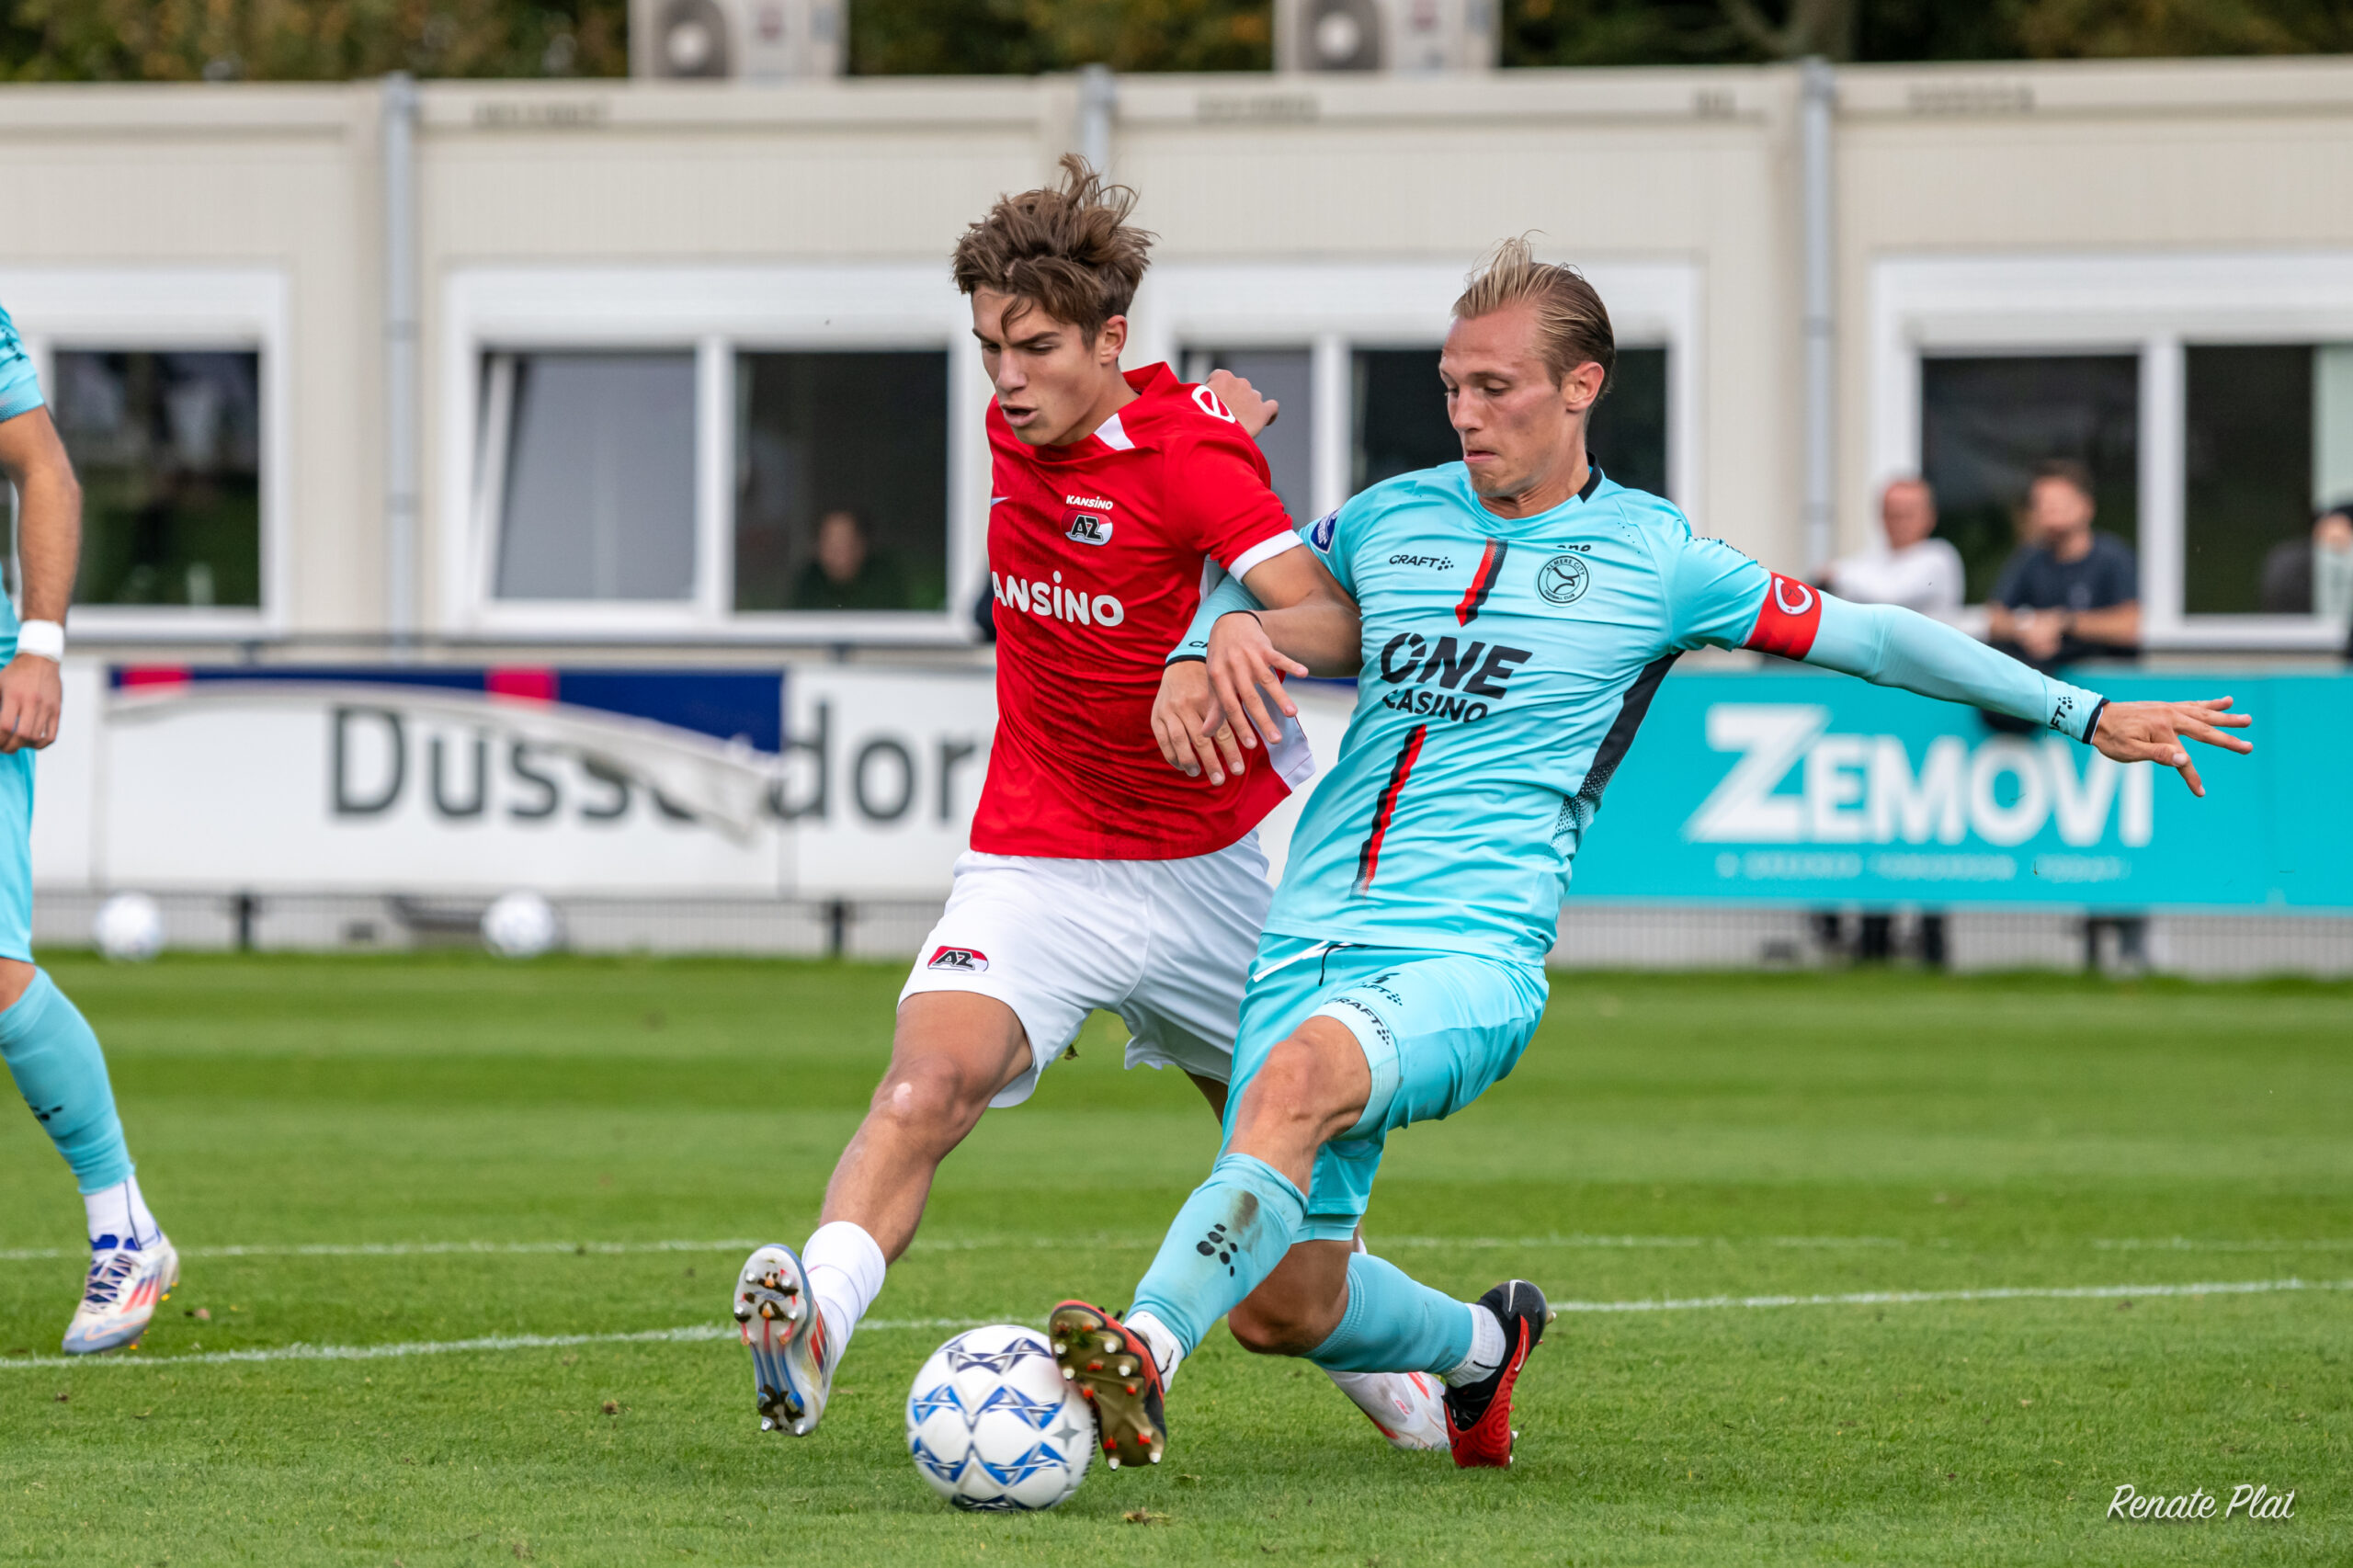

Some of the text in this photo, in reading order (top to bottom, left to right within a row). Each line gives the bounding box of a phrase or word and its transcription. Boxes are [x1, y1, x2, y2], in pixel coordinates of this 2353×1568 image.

[1070, 514, 1104, 541] AZ
[1389, 554, 1440, 568] CRAFT
[1546, 558, 1586, 575] ALMERE CITY
[1381, 632, 1533, 699] ONE
[1381, 688, 1488, 723] CASINO
[1683, 702, 2154, 847] ZEMOVI
[932, 949, 976, 971] AZ
